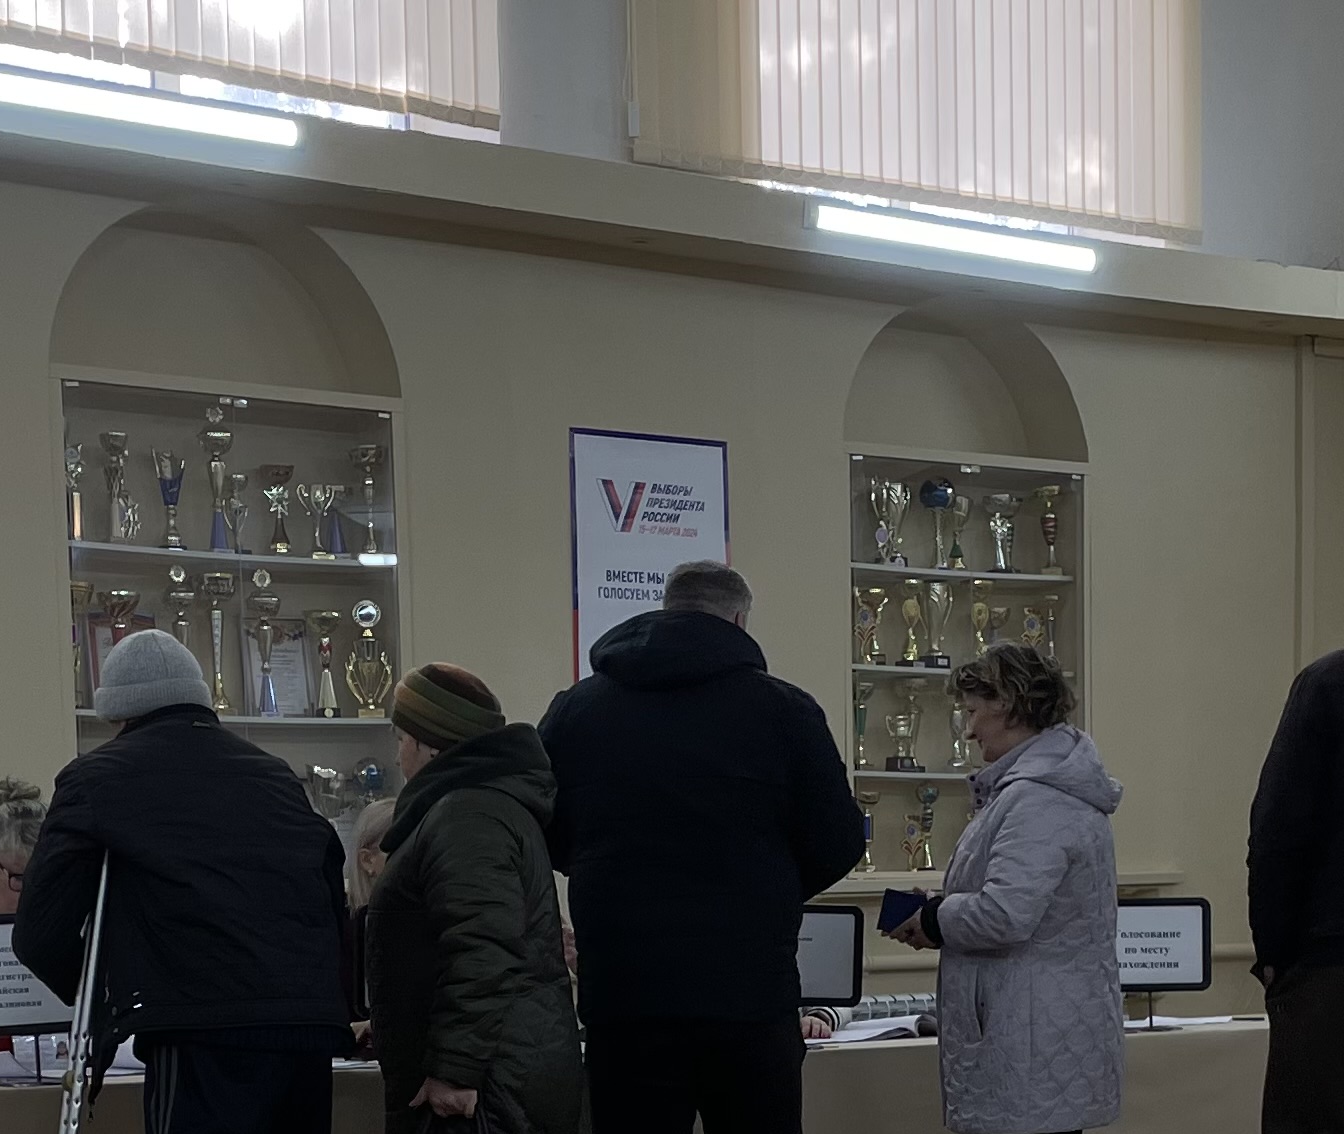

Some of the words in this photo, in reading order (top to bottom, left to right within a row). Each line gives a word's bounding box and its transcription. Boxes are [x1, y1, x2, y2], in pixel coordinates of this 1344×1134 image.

[650, 483, 694, 496] ВЫБОРЫ
[646, 497, 705, 512] ПРЕЗИДЕНТА
[641, 511, 680, 524] РОССИИ
[658, 526, 681, 537] МАРТА
[605, 569, 645, 584] ВМЕСТЕ
[647, 572, 665, 585] МЫ
[597, 586, 650, 601] ГОЛОСУЕМ
[1118, 929, 1181, 938] олосование
[1140, 947, 1170, 956] месту
